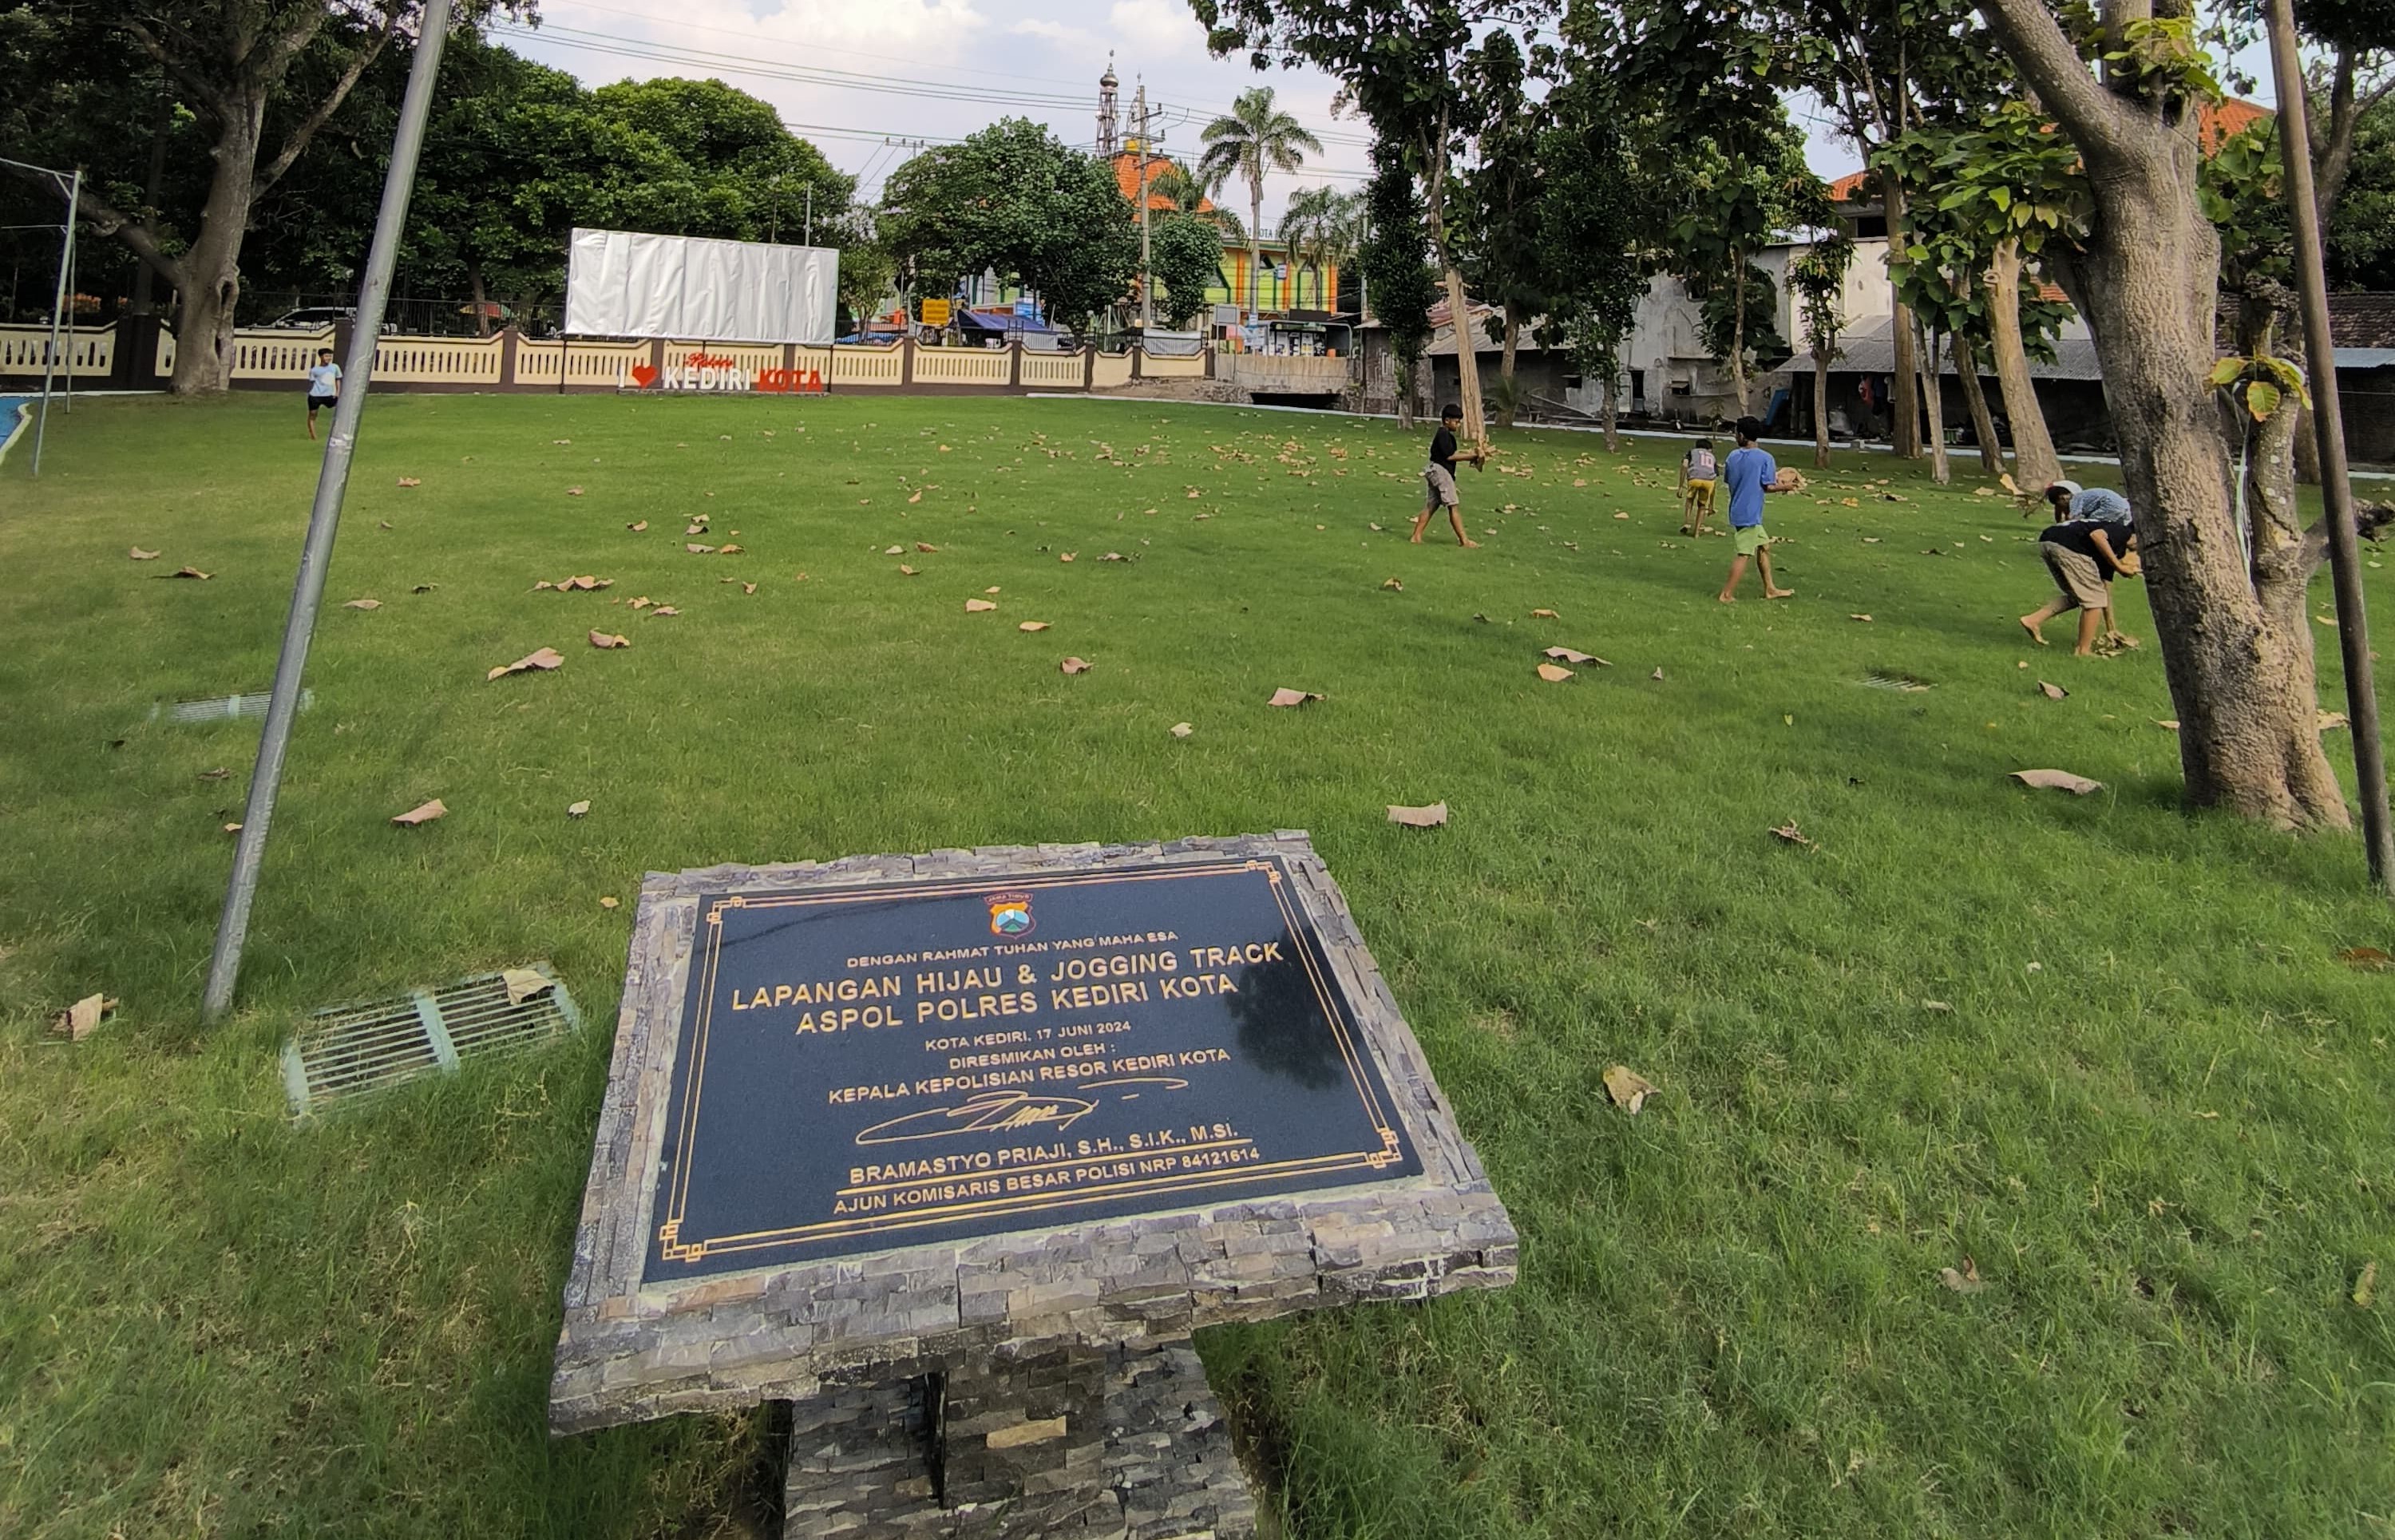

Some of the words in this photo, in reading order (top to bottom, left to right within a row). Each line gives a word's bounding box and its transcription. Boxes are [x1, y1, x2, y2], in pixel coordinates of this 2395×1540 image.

[662, 366, 751, 391] KEDIRI
[757, 369, 821, 393] KOTA
[732, 975, 901, 1011] LAPANGAN
[916, 966, 1002, 995] HIJAU
[1017, 964, 1035, 985] &
[1050, 951, 1177, 982] JOGGING
[1189, 941, 1284, 969] TRACK
[846, 952, 917, 968] DENGAN
[922, 946, 988, 962] RAHMAT
[993, 942, 1048, 956] TUHAN
[1051, 937, 1095, 951] YANG
[1099, 934, 1145, 947] MAHA
[1146, 932, 1177, 943] ESA
[795, 1005, 904, 1035] ASPOL
[916, 991, 1038, 1023] POLRES
[1051, 980, 1149, 1011] KEDIRI
[1159, 973, 1238, 1000] KOTA
[924, 1036, 970, 1051] KOTA
[1036, 1027, 1051, 1040] 17
[1057, 1024, 1093, 1038] JUNI
[1096, 1021, 1130, 1035] 2024
[948, 1047, 1056, 1070] DIRESMIKAN
[1059, 1043, 1106, 1059] OLEH
[829, 1083, 911, 1105] KEPALA
[915, 1069, 1035, 1095] KEPOLISIAN
[1039, 1060, 1108, 1081] RESOR
[1111, 1053, 1176, 1073] KEDIRI
[1178, 1048, 1231, 1066] KOTA
[833, 1194, 887, 1215] AJUN
[893, 1178, 1001, 1206] KOMISARIS
[1006, 1170, 1071, 1191] BESAR
[1075, 1162, 1136, 1182] POLISI
[1139, 1157, 1177, 1174] NRP
[1182, 1146, 1261, 1169] 84121614
[849, 1151, 992, 1184] BRAMASTYO
[996, 1142, 1072, 1166] PRIAJI,
[1077, 1137, 1124, 1156] S.H.,
[1129, 1130, 1186, 1150] S.I.K.,
